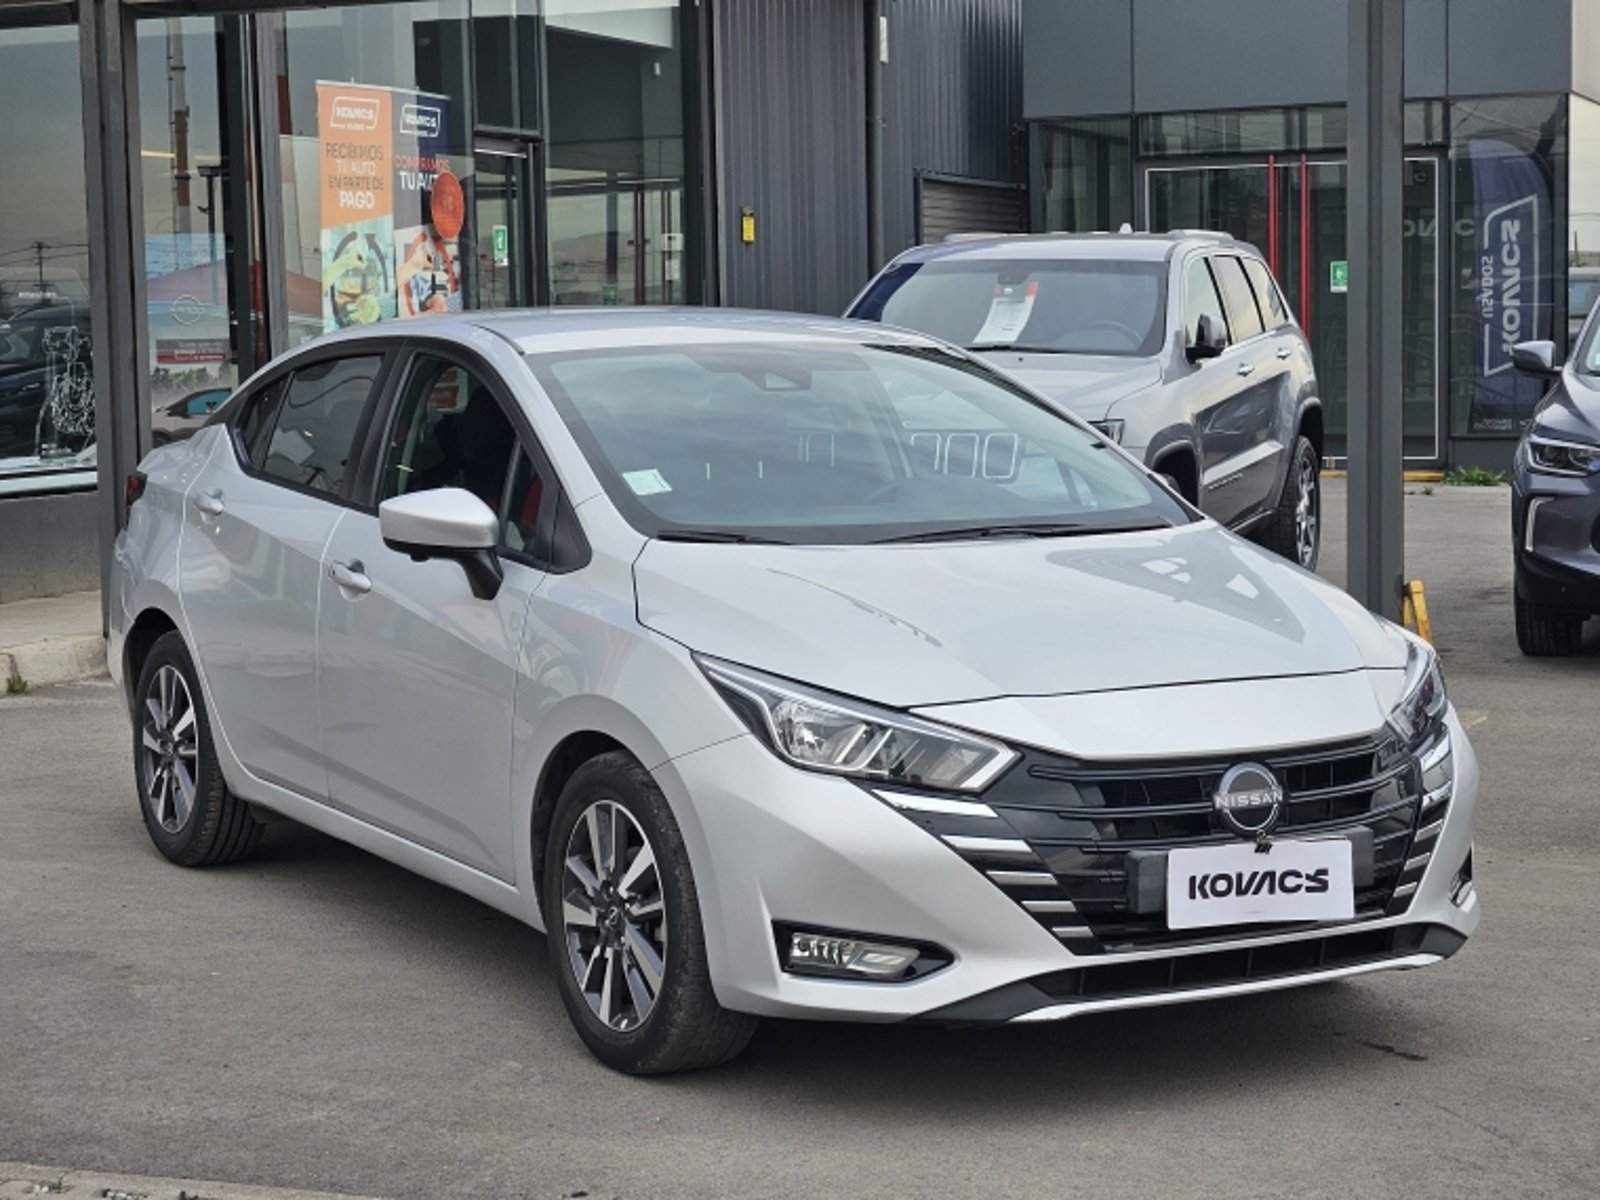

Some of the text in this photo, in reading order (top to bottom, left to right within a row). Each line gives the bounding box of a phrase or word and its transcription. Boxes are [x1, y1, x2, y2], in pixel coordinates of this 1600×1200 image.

[326, 142, 384, 160] RECIBIMOS
[335, 160, 348, 174] TU
[343, 176, 371, 191] PARTE
[398, 170, 416, 191] TU
[340, 190, 375, 209] PAGO
[1214, 790, 1283, 809] NISSAN
[1188, 867, 1330, 901] KOVACS
